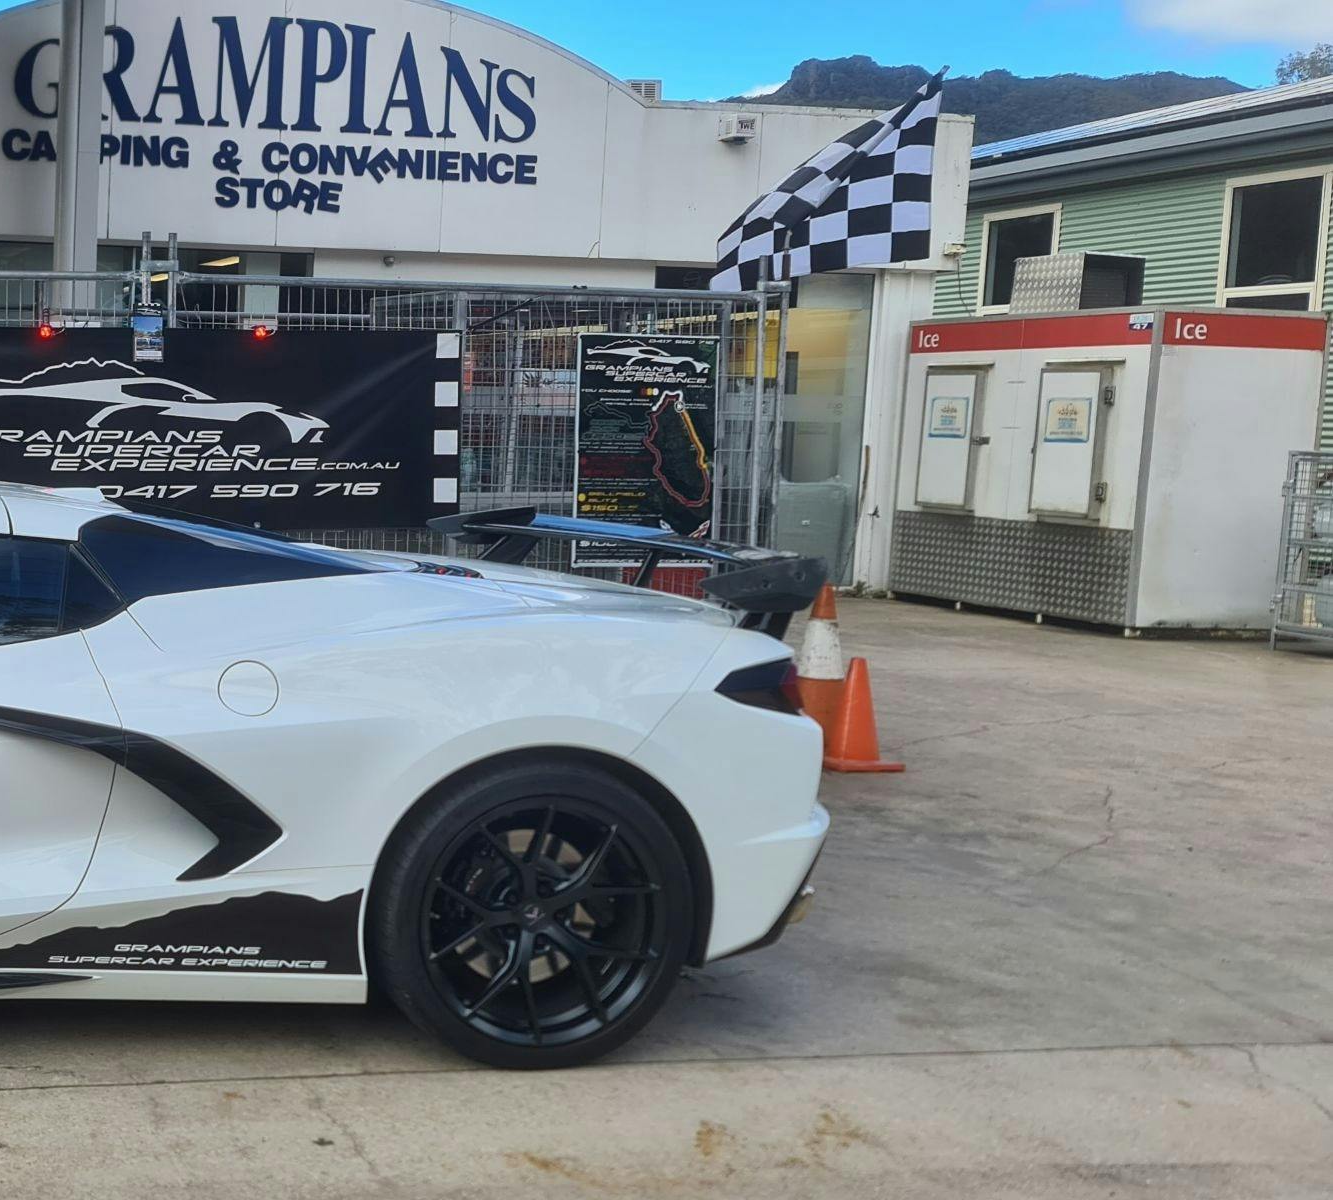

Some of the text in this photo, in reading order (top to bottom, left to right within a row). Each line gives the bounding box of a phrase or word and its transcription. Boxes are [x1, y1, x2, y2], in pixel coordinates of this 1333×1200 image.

[14, 15, 537, 143] GRAMPIANS
[2, 128, 538, 185] CAPING & CONVENIENCE
[215, 176, 344, 215] STORE
[1174, 317, 1208, 340] Ice
[918, 330, 940, 348] Ice
[584, 364, 674, 373] GRAMPIANS
[604, 370, 687, 378] SUPERCAR
[613, 376, 708, 384] EXPERIENCE
[23, 444, 261, 458] SUPERCAR
[100, 482, 382, 499] 0417 590 716
[113, 943, 263, 955] GRAMPIANS
[47, 955, 328, 969] SUPERCAR EXPERIENCE
